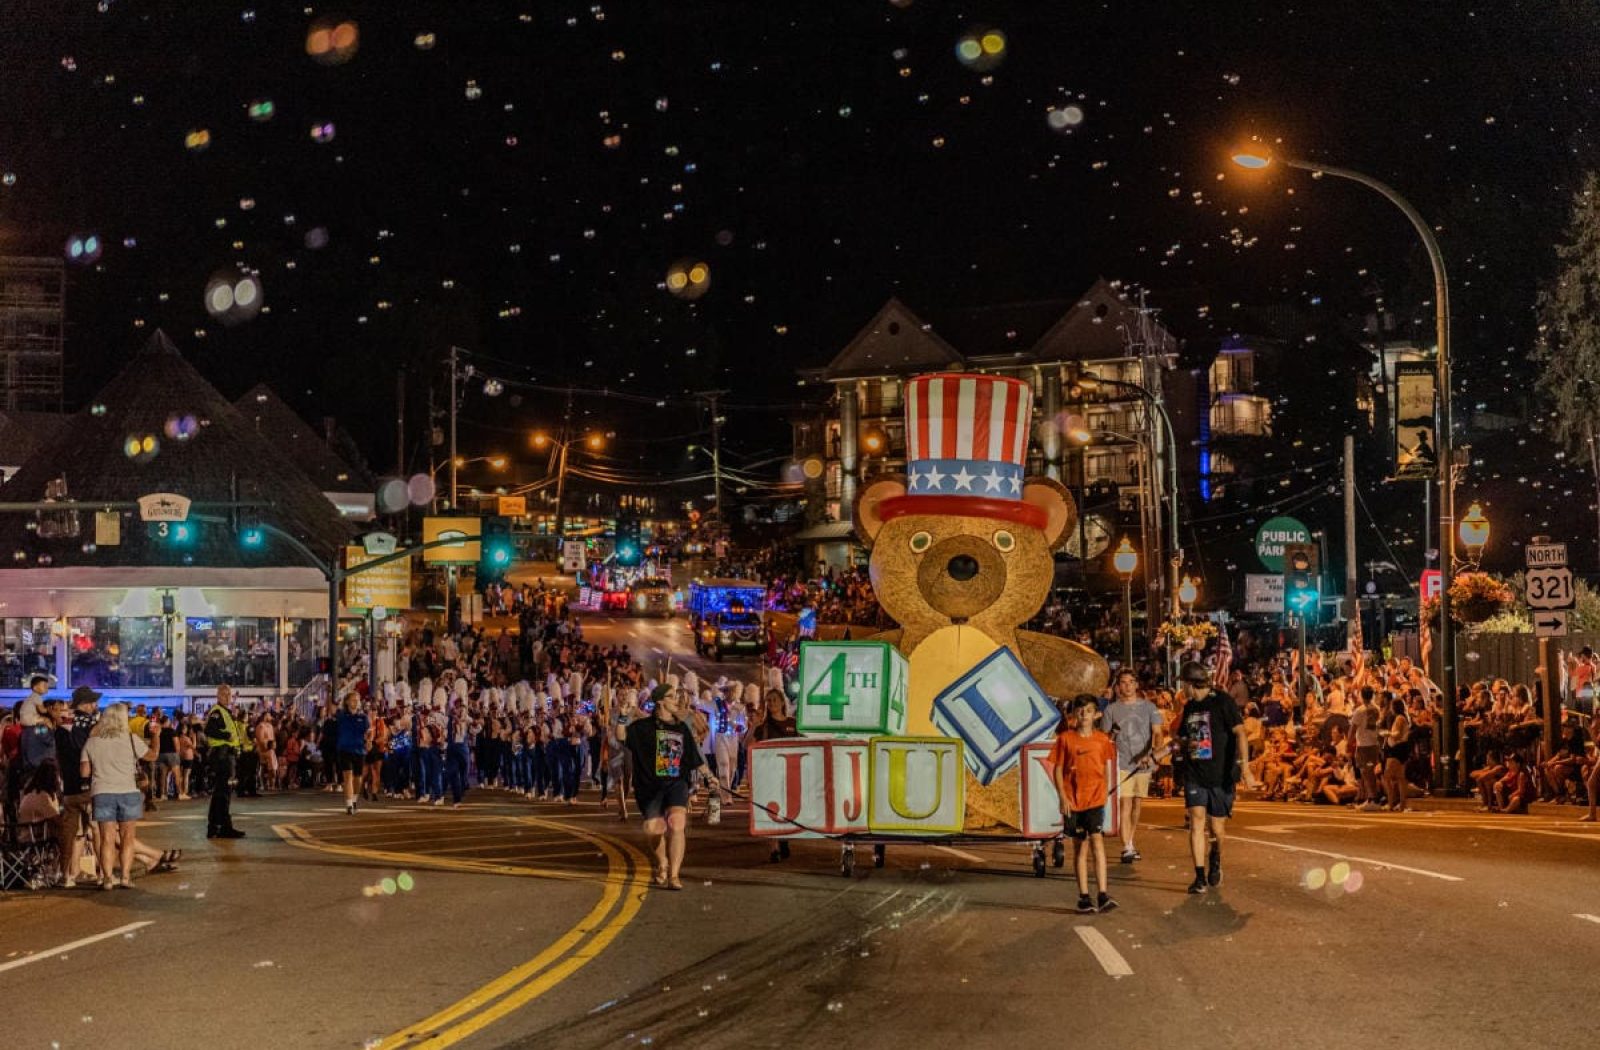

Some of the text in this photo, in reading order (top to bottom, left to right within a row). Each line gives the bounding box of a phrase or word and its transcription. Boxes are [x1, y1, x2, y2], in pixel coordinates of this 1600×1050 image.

[1262, 531, 1305, 542] PUBLIC
[1529, 550, 1565, 561] NORTH
[1531, 577, 1569, 599] 321
[807, 652, 878, 720] 4TH
[952, 678, 1043, 753] L
[766, 752, 810, 823] J
[843, 751, 863, 821] J
[881, 749, 953, 819] U
